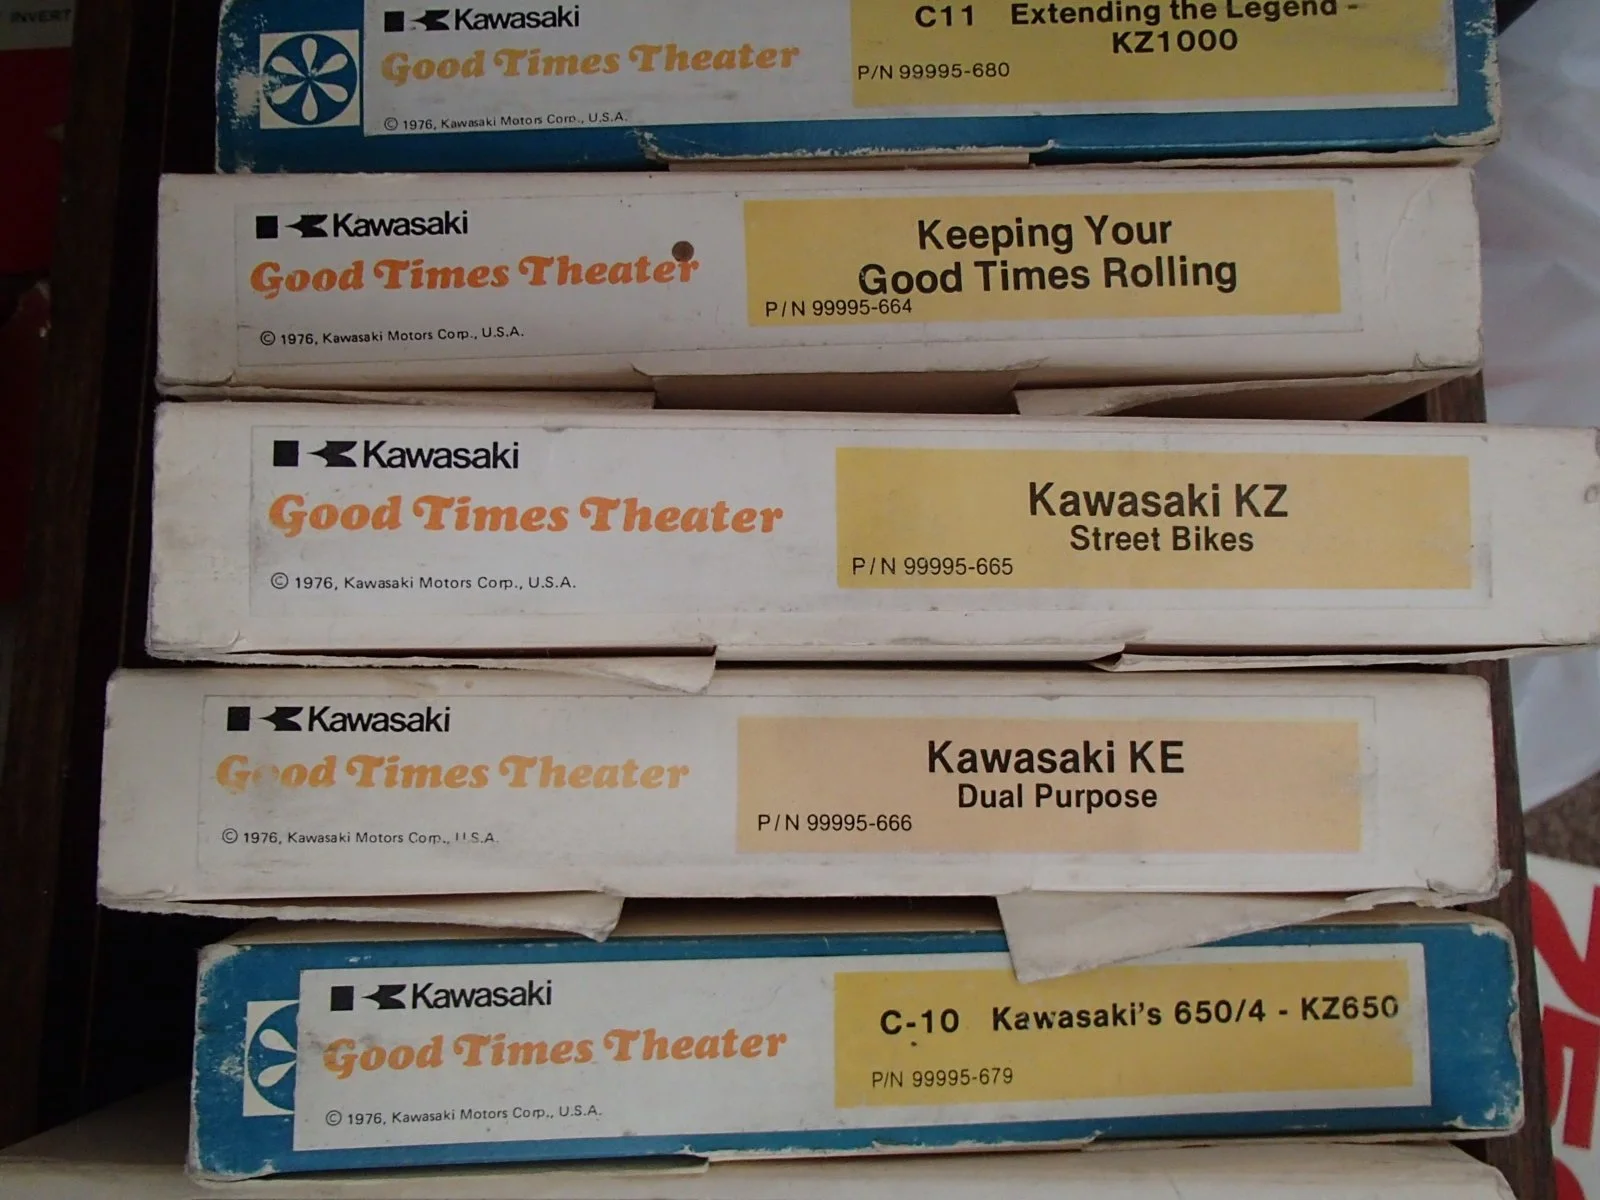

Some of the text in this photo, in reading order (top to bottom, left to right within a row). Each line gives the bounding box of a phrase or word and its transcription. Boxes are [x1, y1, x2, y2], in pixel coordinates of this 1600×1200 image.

[455, 5, 579, 30] Kawasaki
[915, 5, 975, 27] C11
[1012, 1, 1160, 26] Extending
[1170, 0, 1216, 20] the
[1227, 0, 1337, 22] Legend
[1113, 29, 1237, 53] KZ1000
[382, 43, 799, 85] Good Times Theater
[858, 62, 1009, 80] P/N 99995-680
[404, 119, 436, 130] 1976,
[442, 118, 495, 128] Kawasaki
[501, 116, 542, 125] Motors
[589, 112, 627, 123] U.S.A.
[334, 210, 467, 237] Kawasaki
[918, 215, 1172, 256] Keeping Your
[251, 256, 699, 299] Good Times Theater
[859, 255, 1236, 295] Good Times Rolling
[766, 299, 912, 317] P/N 99995-664
[281, 333, 317, 345] 1976,
[323, 332, 382, 343] Kawasaki
[388, 331, 433, 340] Motors
[438, 329, 478, 342] Corp.,
[482, 327, 524, 338] U.S.A.
[364, 440, 518, 469] Kawasaki
[1030, 482, 1288, 517] Kawasaki KZ
[269, 495, 783, 536] Good Times Theater
[1071, 525, 1253, 551] Street Bikes
[853, 557, 1012, 575] P/N 99995-665
[296, 577, 337, 590] 1976,
[345, 577, 413, 589] Kawasaki
[420, 577, 471, 588] Motors
[478, 577, 524, 592] Corp.,
[529, 576, 575, 588] U.S.A.
[309, 706, 450, 732] Kawasaki
[929, 741, 1184, 773] Kawasaki KE
[347, 755, 487, 788] Times
[499, 755, 688, 788] Theater
[959, 783, 1157, 814] Dual Purpose
[759, 814, 912, 831] P/N 99995-666
[244, 832, 281, 844] 1976,
[288, 832, 350, 843] Kawasaki
[356, 832, 403, 843] Motors
[409, 832, 449, 844] Corp.,
[412, 980, 551, 1009] Kawasaki
[881, 1009, 958, 1035] C-10
[993, 1002, 1161, 1031] Kawasaki's
[1175, 999, 1265, 1024] 650/4
[1302, 995, 1398, 1020] KZ650
[324, 1029, 787, 1079] Good Times Theater
[873, 1067, 1012, 1088] P/N 99995-679
[348, 1113, 385, 1125] 1976,
[392, 1111, 454, 1123] Kawasaki
[461, 1109, 507, 1119] Motors
[513, 1107, 553, 1119] Corp.,
[560, 1105, 601, 1117] U.S.A.
